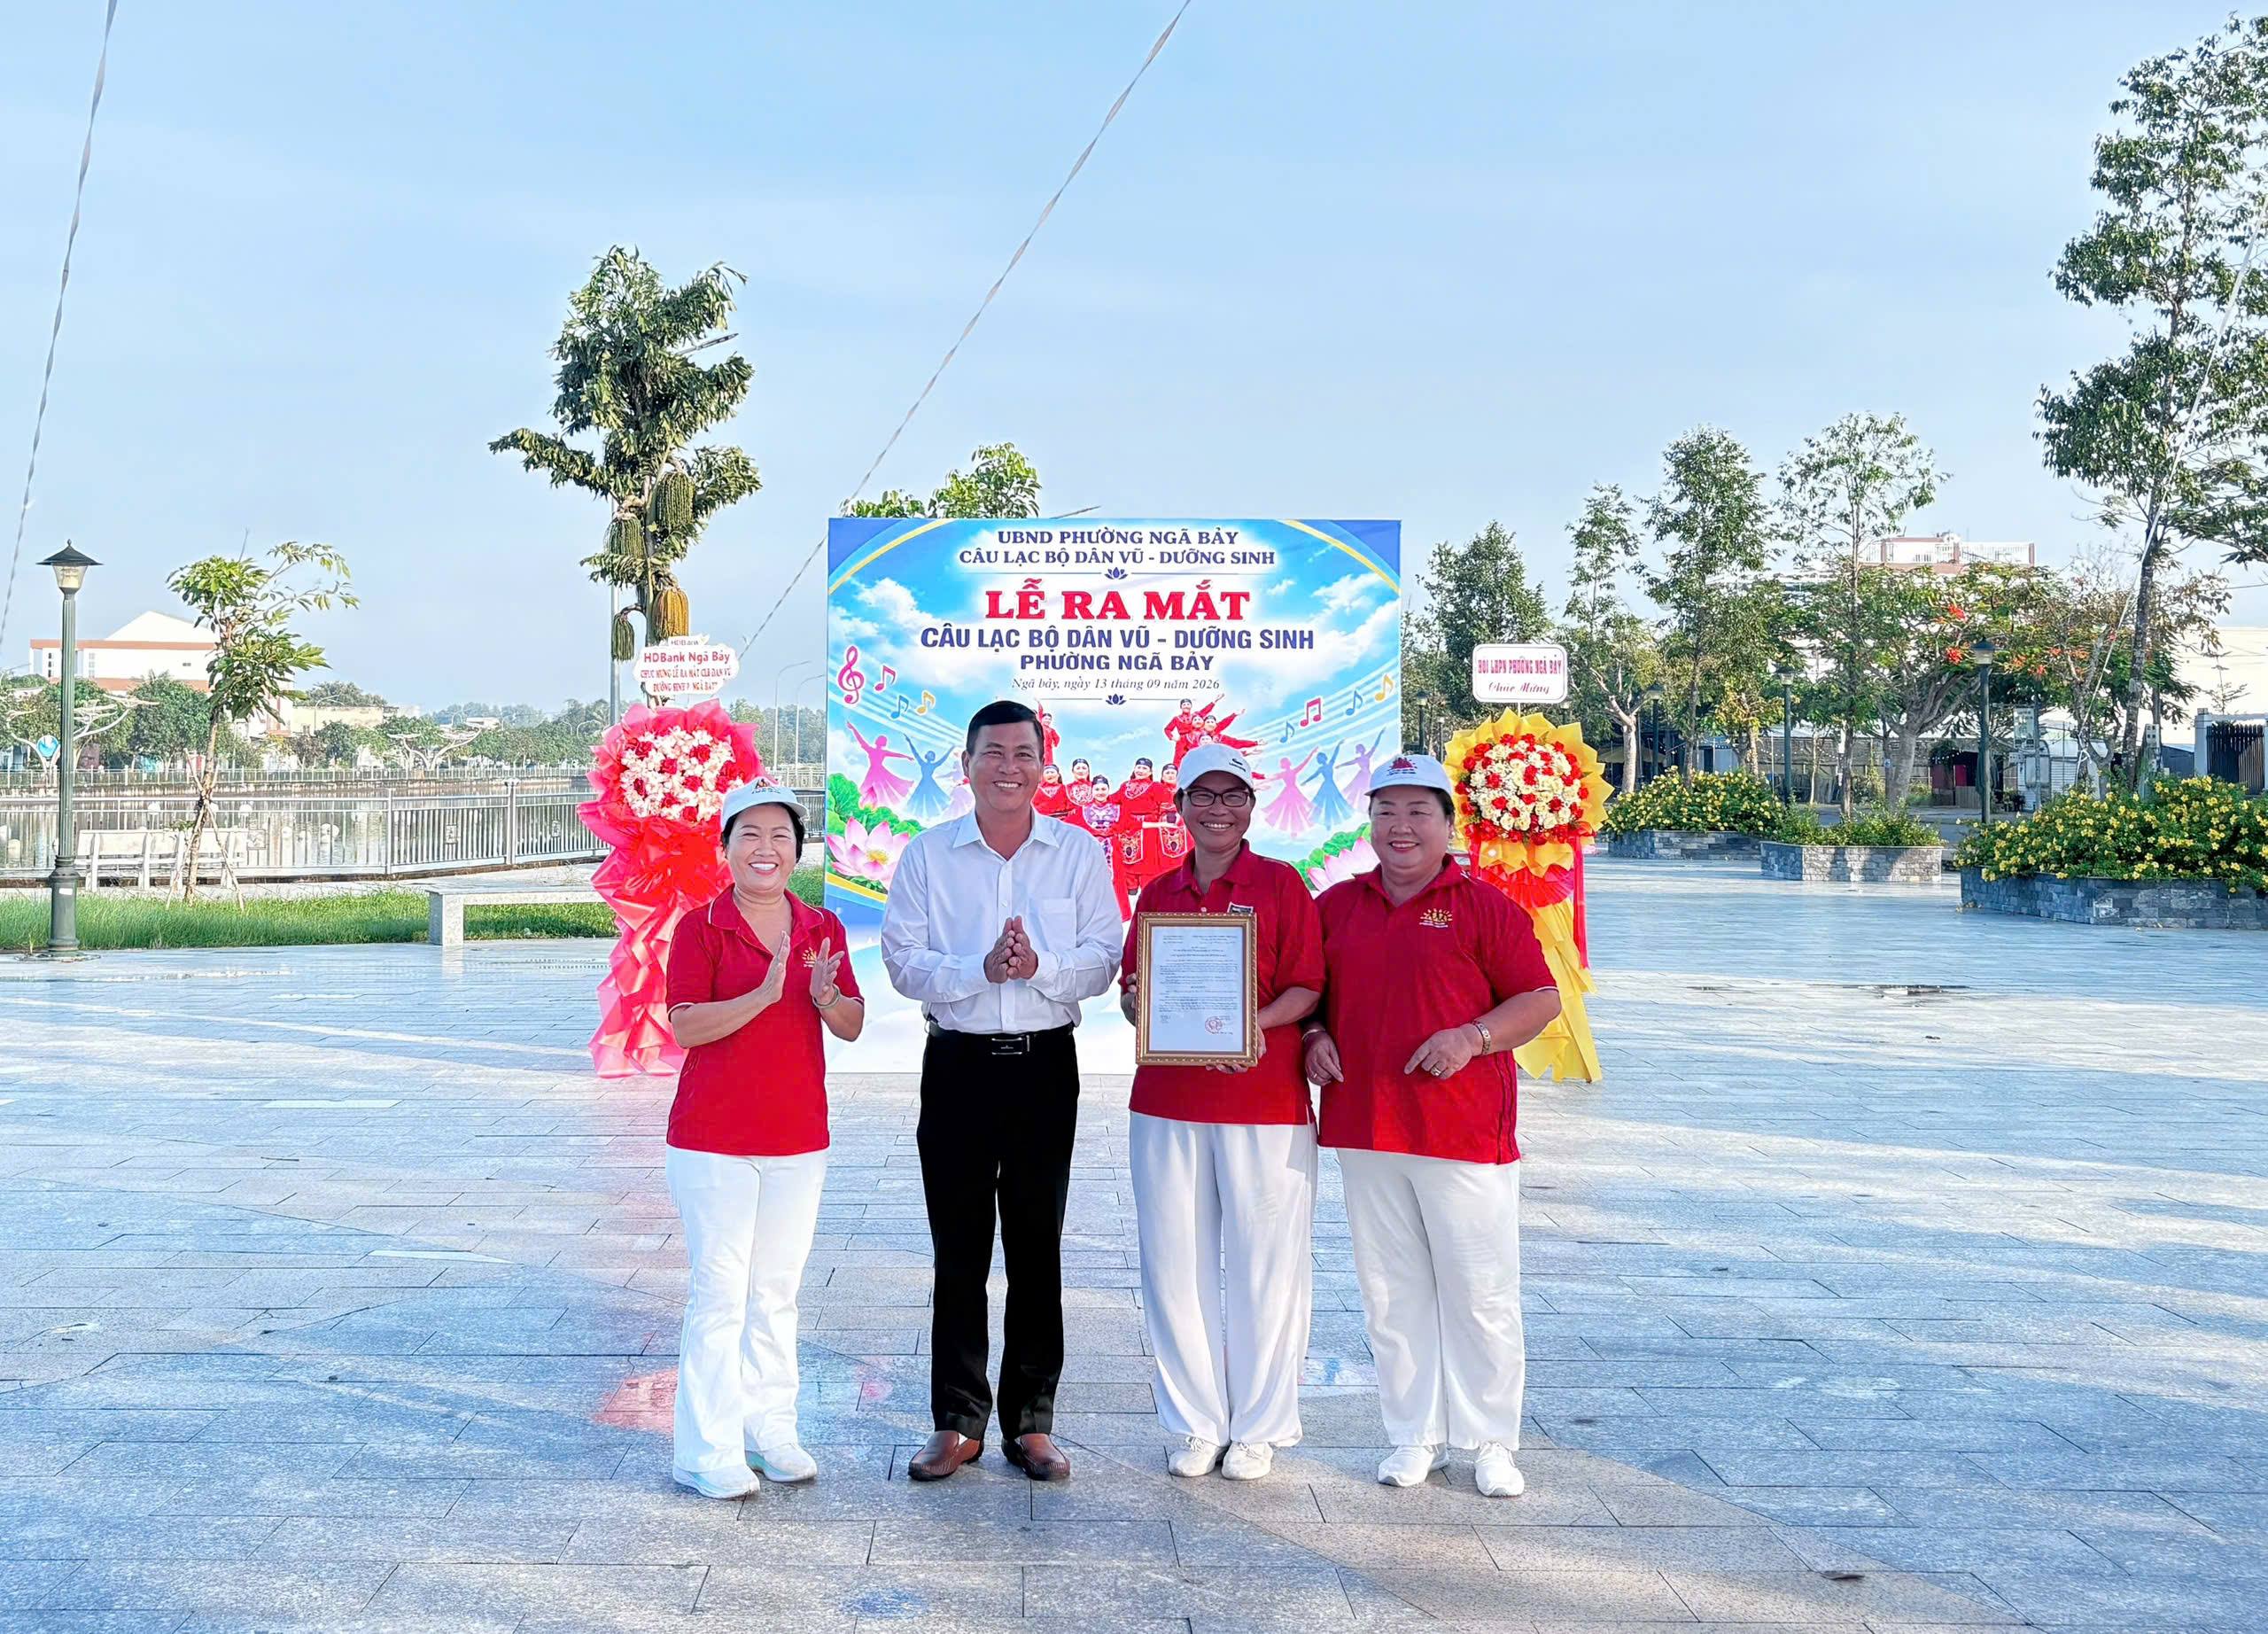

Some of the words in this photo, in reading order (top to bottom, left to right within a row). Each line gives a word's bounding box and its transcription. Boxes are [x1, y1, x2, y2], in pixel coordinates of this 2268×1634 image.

[998, 531, 1053, 544] UBND
[1059, 526, 1144, 545] PHƯỜNG
[1149, 528, 1192, 545] NGÃ
[1198, 527, 1239, 545] BẢY
[959, 547, 998, 564] CÂU
[1003, 550, 1040, 567] LẠC
[1045, 547, 1070, 567] BỘ
[1075, 547, 1115, 564] DÂN
[1118, 548, 1145, 564] VŨ
[1159, 548, 1225, 564] DƯỠNG
[1231, 550, 1275, 564] SINH
[985, 578, 1046, 620] LỄ
[1060, 590, 1131, 620] RA
[1143, 579, 1251, 621] MẮT
[920, 622, 971, 648] CÂU
[977, 628, 1021, 653] LẠC
[1029, 625, 1060, 653] BỘ
[1067, 625, 1113, 649] DÂN
[1120, 626, 1150, 649] VŨ
[1175, 626, 1252, 649] DƯỠNG
[1259, 629, 1314, 650] SINH
[643, 652, 685, 663] HDBank
[688, 651, 709, 665] Ngã
[711, 650, 731, 665] Bảy
[1020, 651, 1111, 671] PHƯỜNG
[1118, 652, 1163, 671] NGÃ
[1170, 651, 1215, 671] BẢY
[1012, 677, 1036, 690] Ngã
[1064, 675, 1091, 690] ngày
[1094, 678, 1107, 689] 13
[1110, 678, 1144, 691] tháng
[1146, 679, 1161, 689] 09
[1163, 680, 1189, 689] năm
[1192, 679, 1220, 689] 2026
